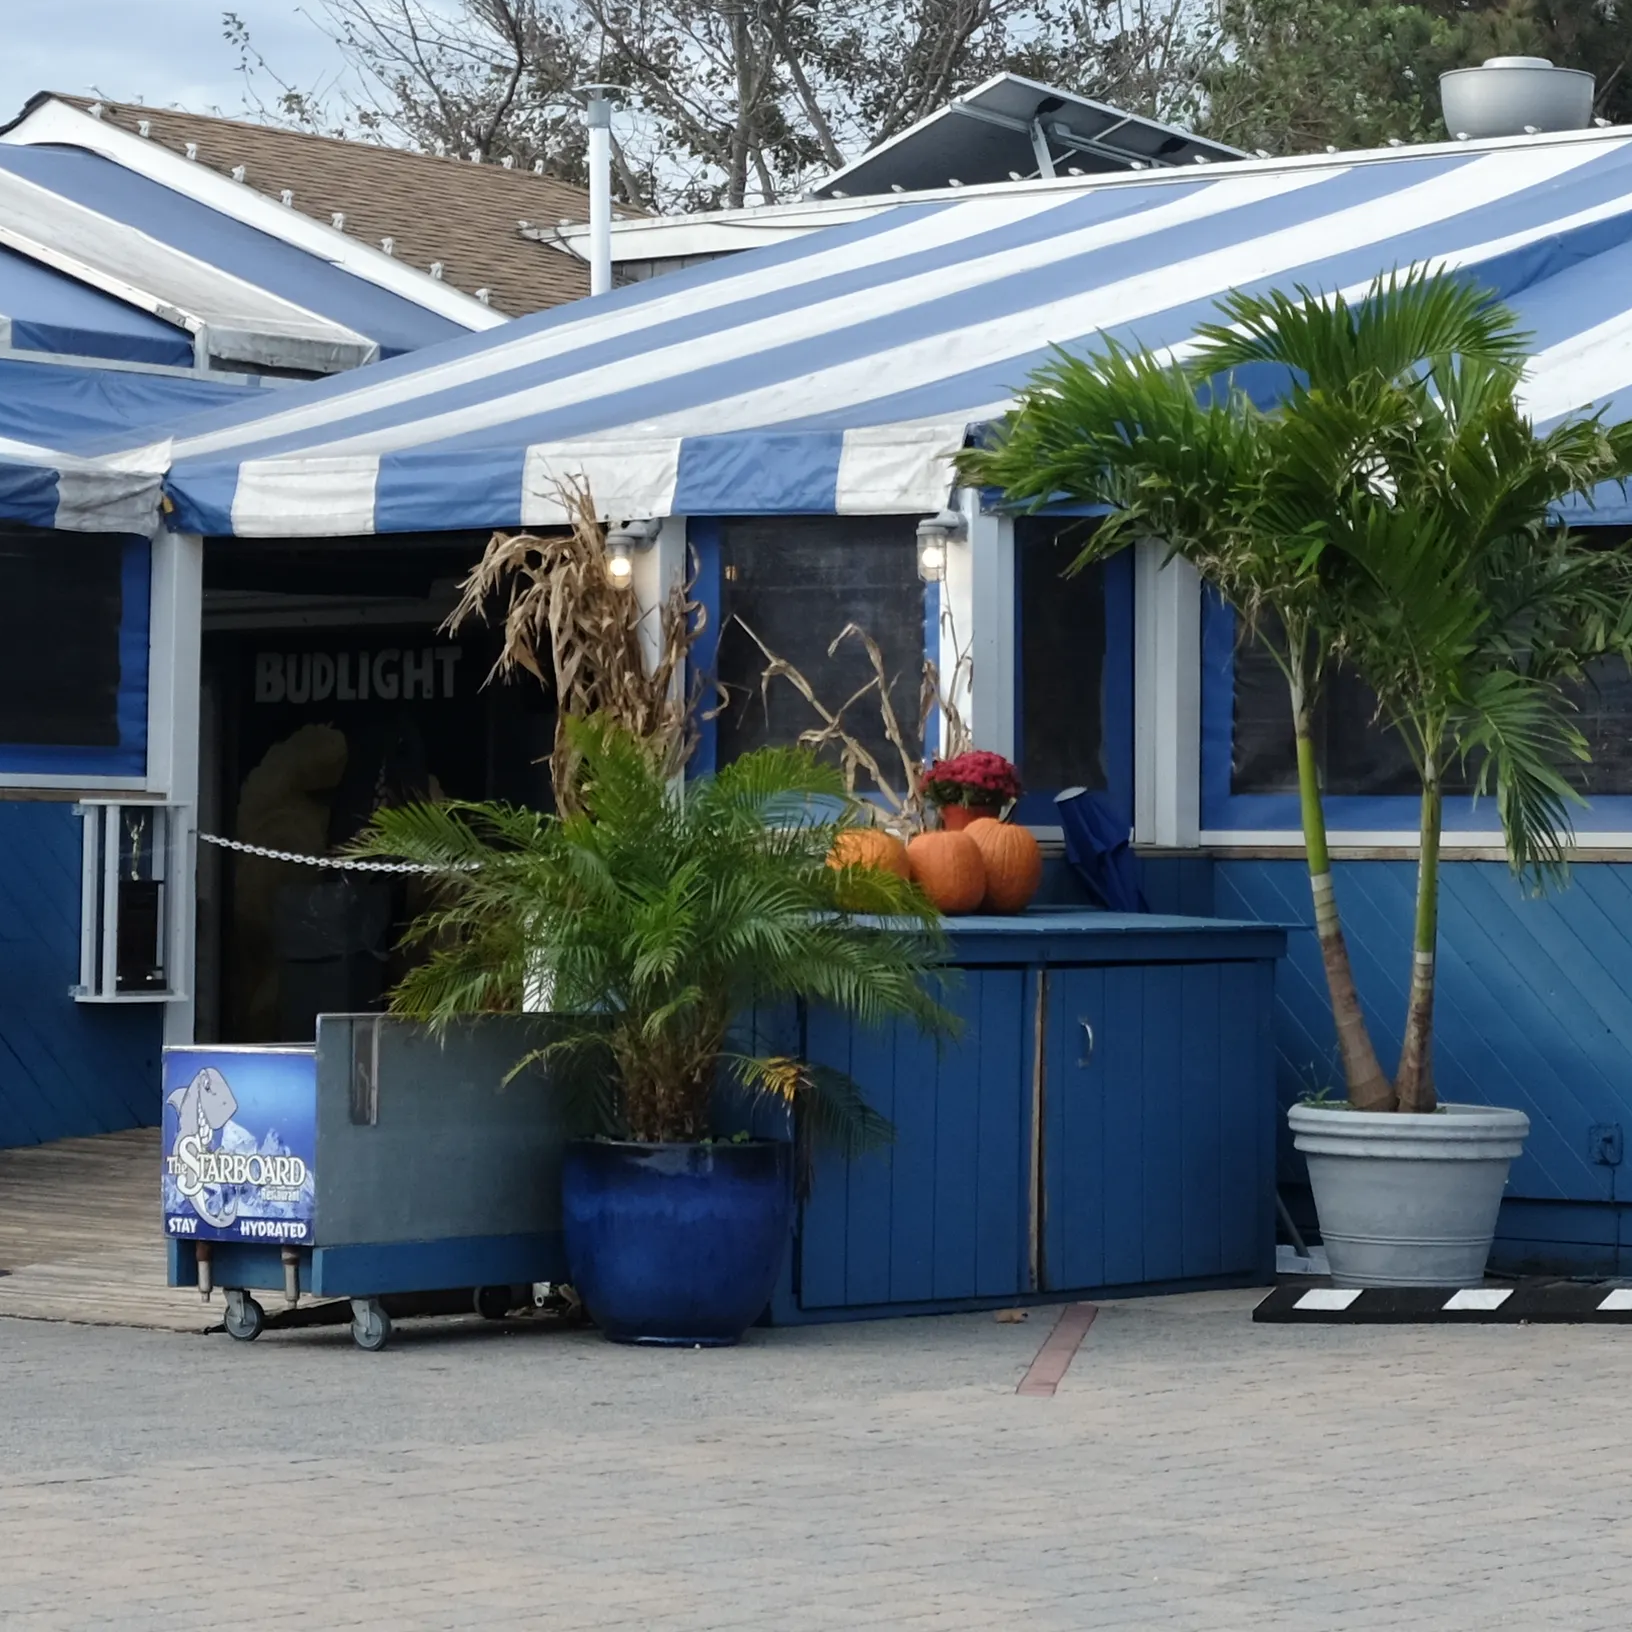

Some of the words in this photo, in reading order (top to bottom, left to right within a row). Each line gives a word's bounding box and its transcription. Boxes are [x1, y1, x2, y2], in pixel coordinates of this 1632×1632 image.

[167, 1156, 187, 1175] The
[176, 1134, 306, 1197] STARBOARD
[169, 1218, 198, 1234] STAY
[240, 1220, 308, 1239] HYDRATED
